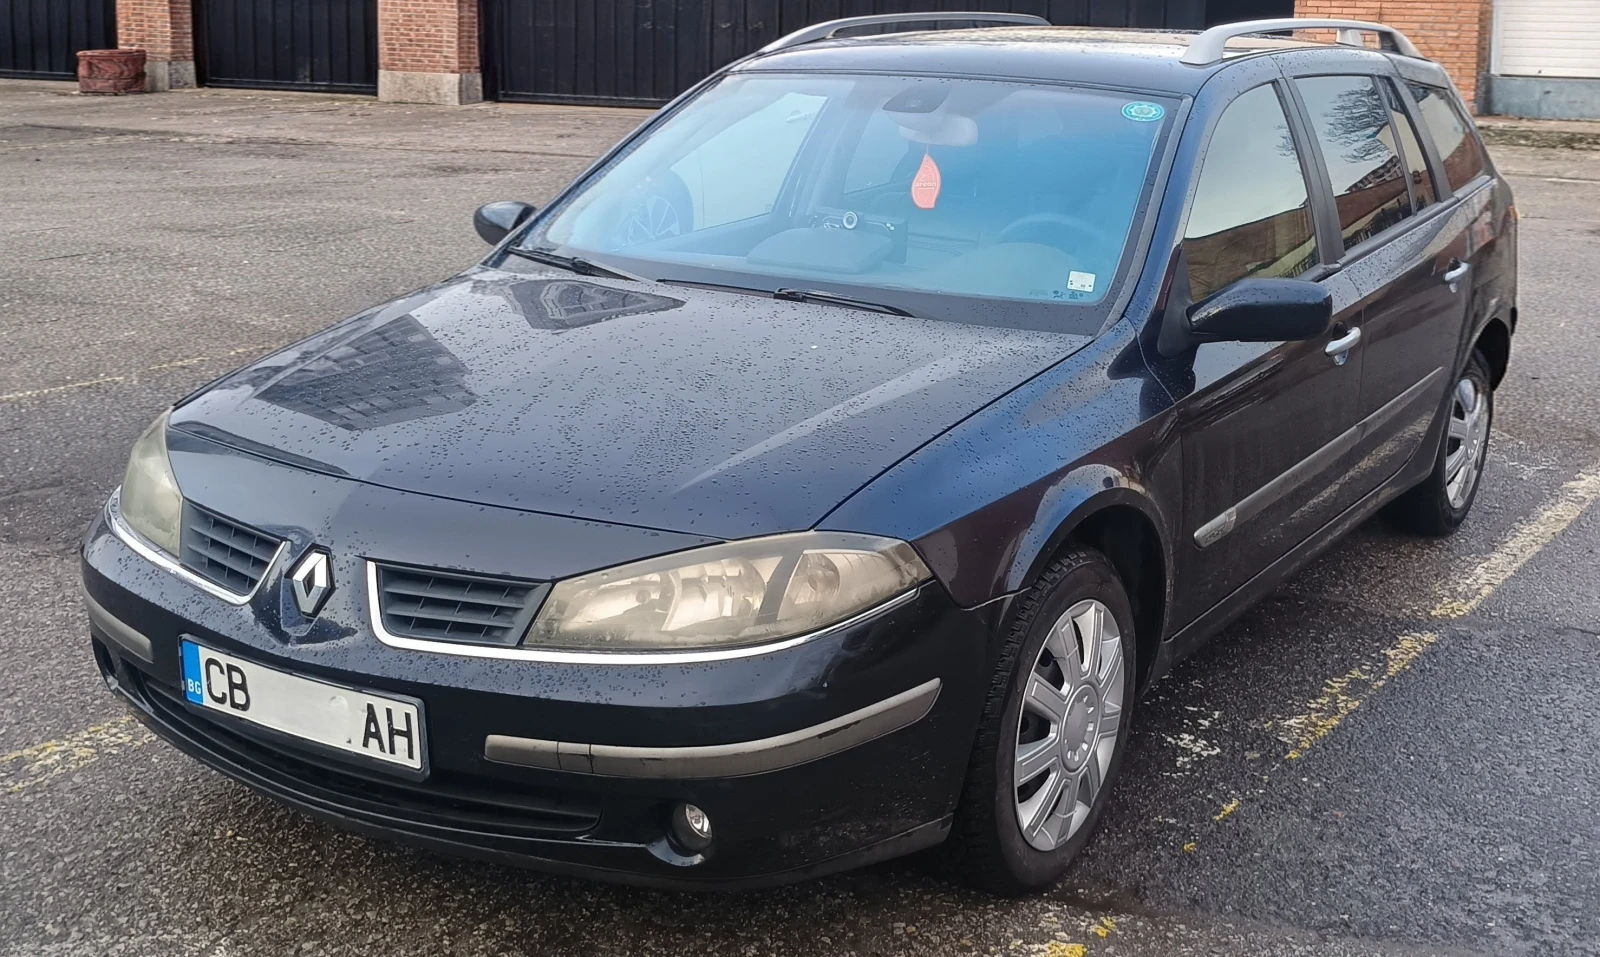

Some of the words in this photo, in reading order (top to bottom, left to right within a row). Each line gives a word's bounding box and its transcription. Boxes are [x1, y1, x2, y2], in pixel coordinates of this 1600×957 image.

[187, 678, 202, 695] BG
[205, 657, 250, 712] CB
[362, 702, 414, 760] AH
